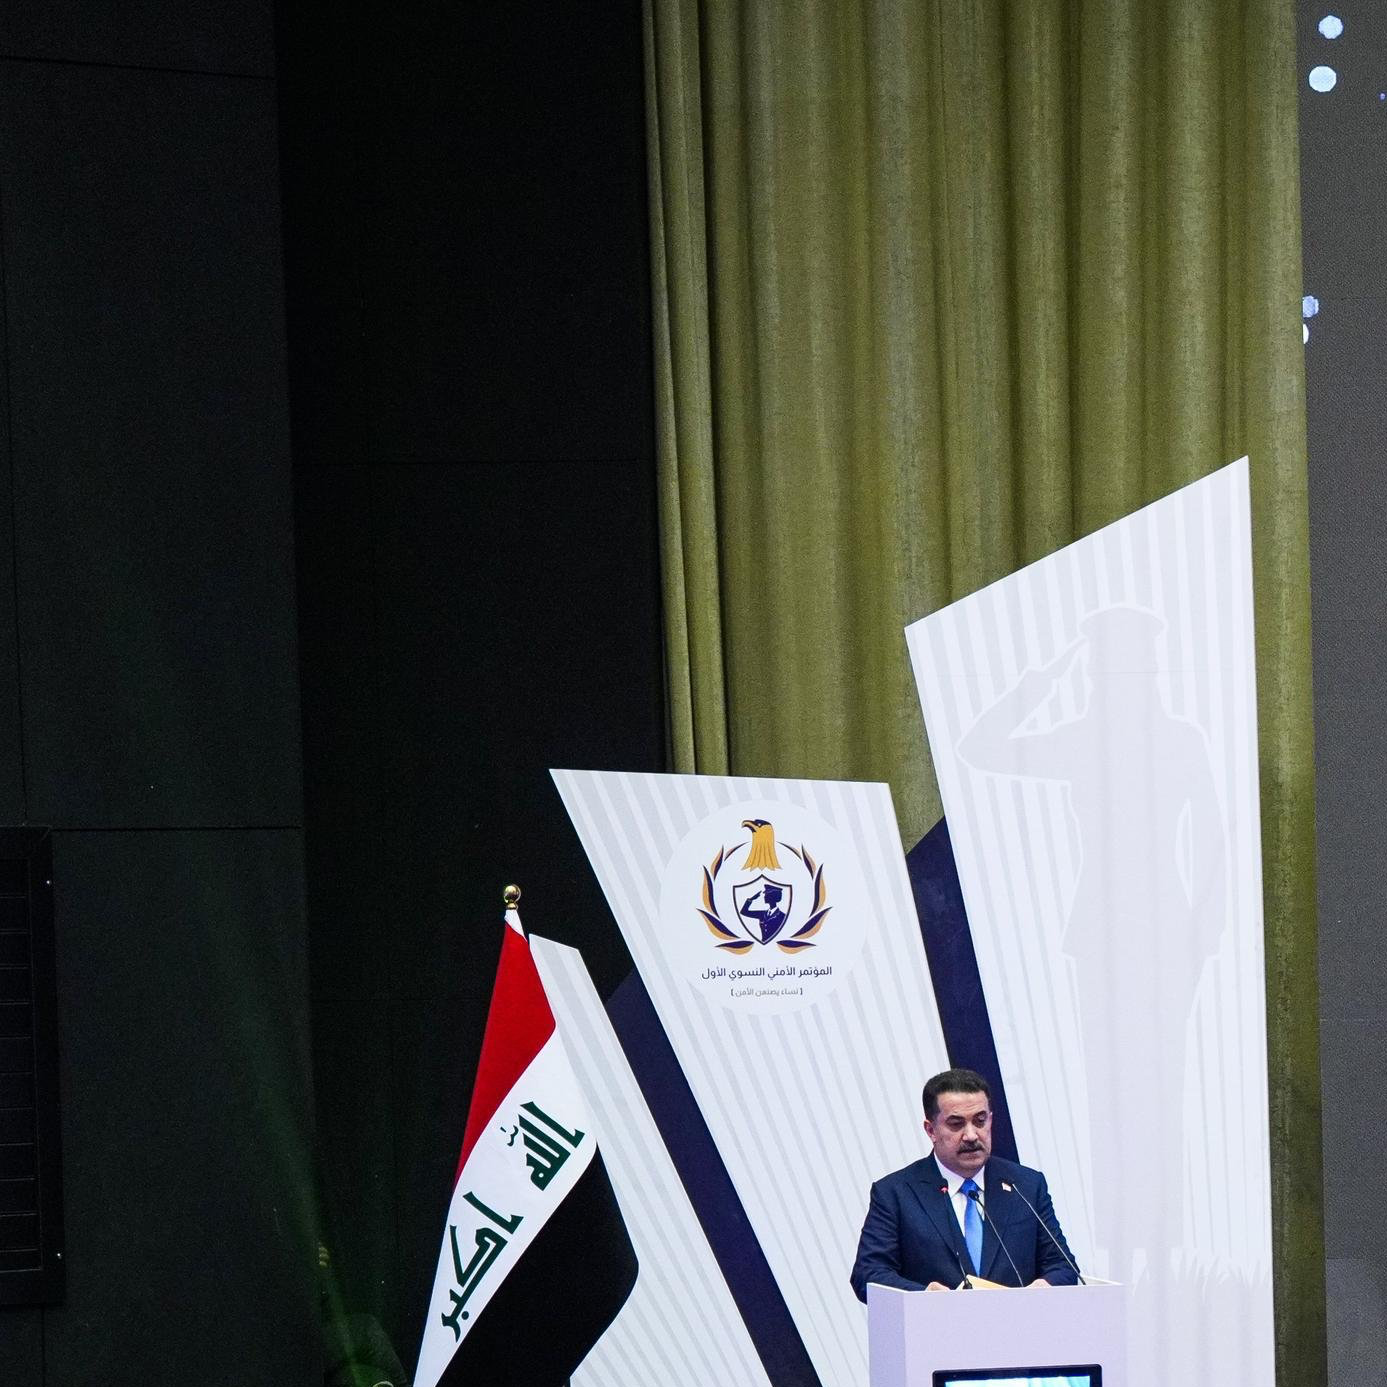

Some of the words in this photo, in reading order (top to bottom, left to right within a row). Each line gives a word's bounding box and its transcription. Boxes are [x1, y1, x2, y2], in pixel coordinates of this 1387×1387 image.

[701, 965, 727, 980] الأول
[728, 967, 765, 981] النسوي
[767, 965, 796, 981] الأمني
[798, 965, 832, 979] المؤتمر
